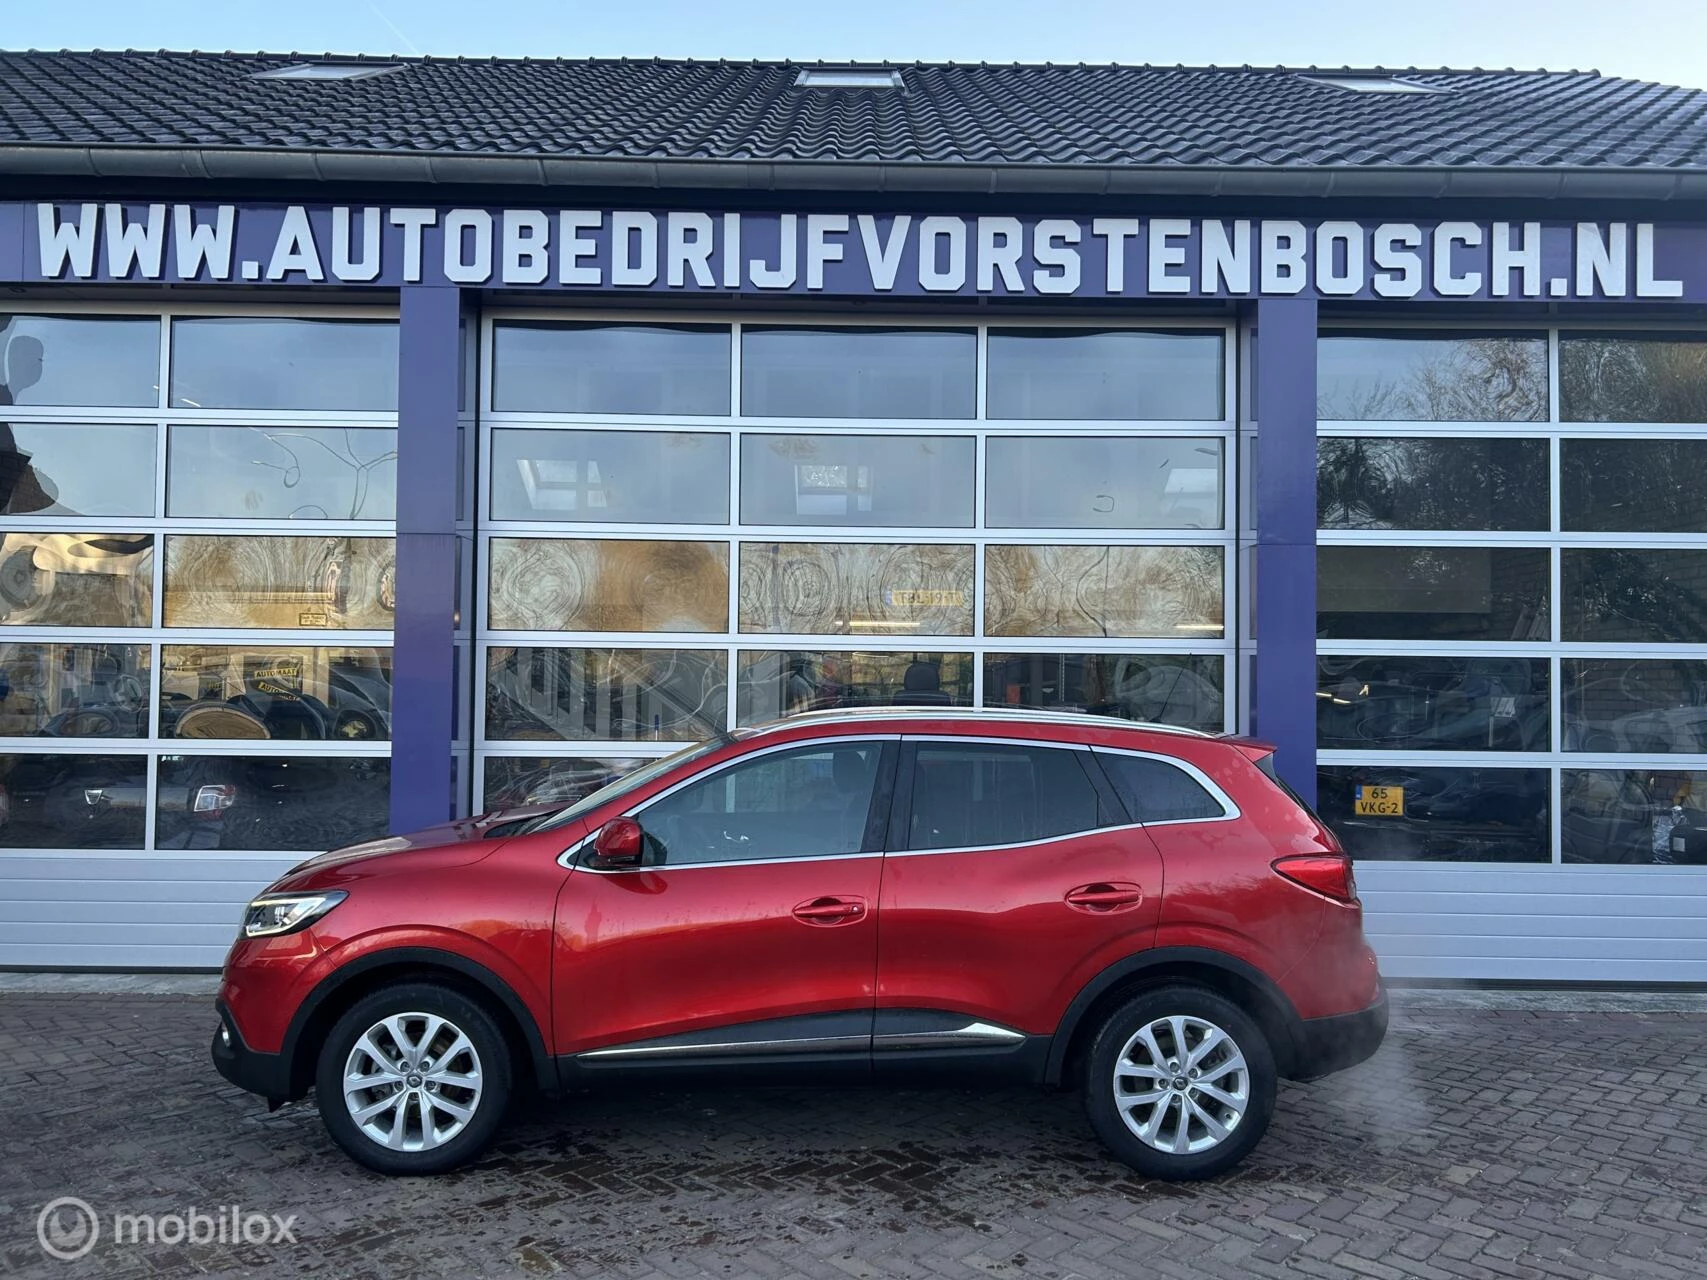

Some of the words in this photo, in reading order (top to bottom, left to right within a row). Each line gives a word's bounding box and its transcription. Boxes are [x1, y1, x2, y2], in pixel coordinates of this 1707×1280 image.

[37, 202, 1685, 298] WWW.AUTOBEDRIJFVORSTENBOSCH.NL
[1371, 787, 1388, 799] 65
[1360, 801, 1399, 814] VKG-2
